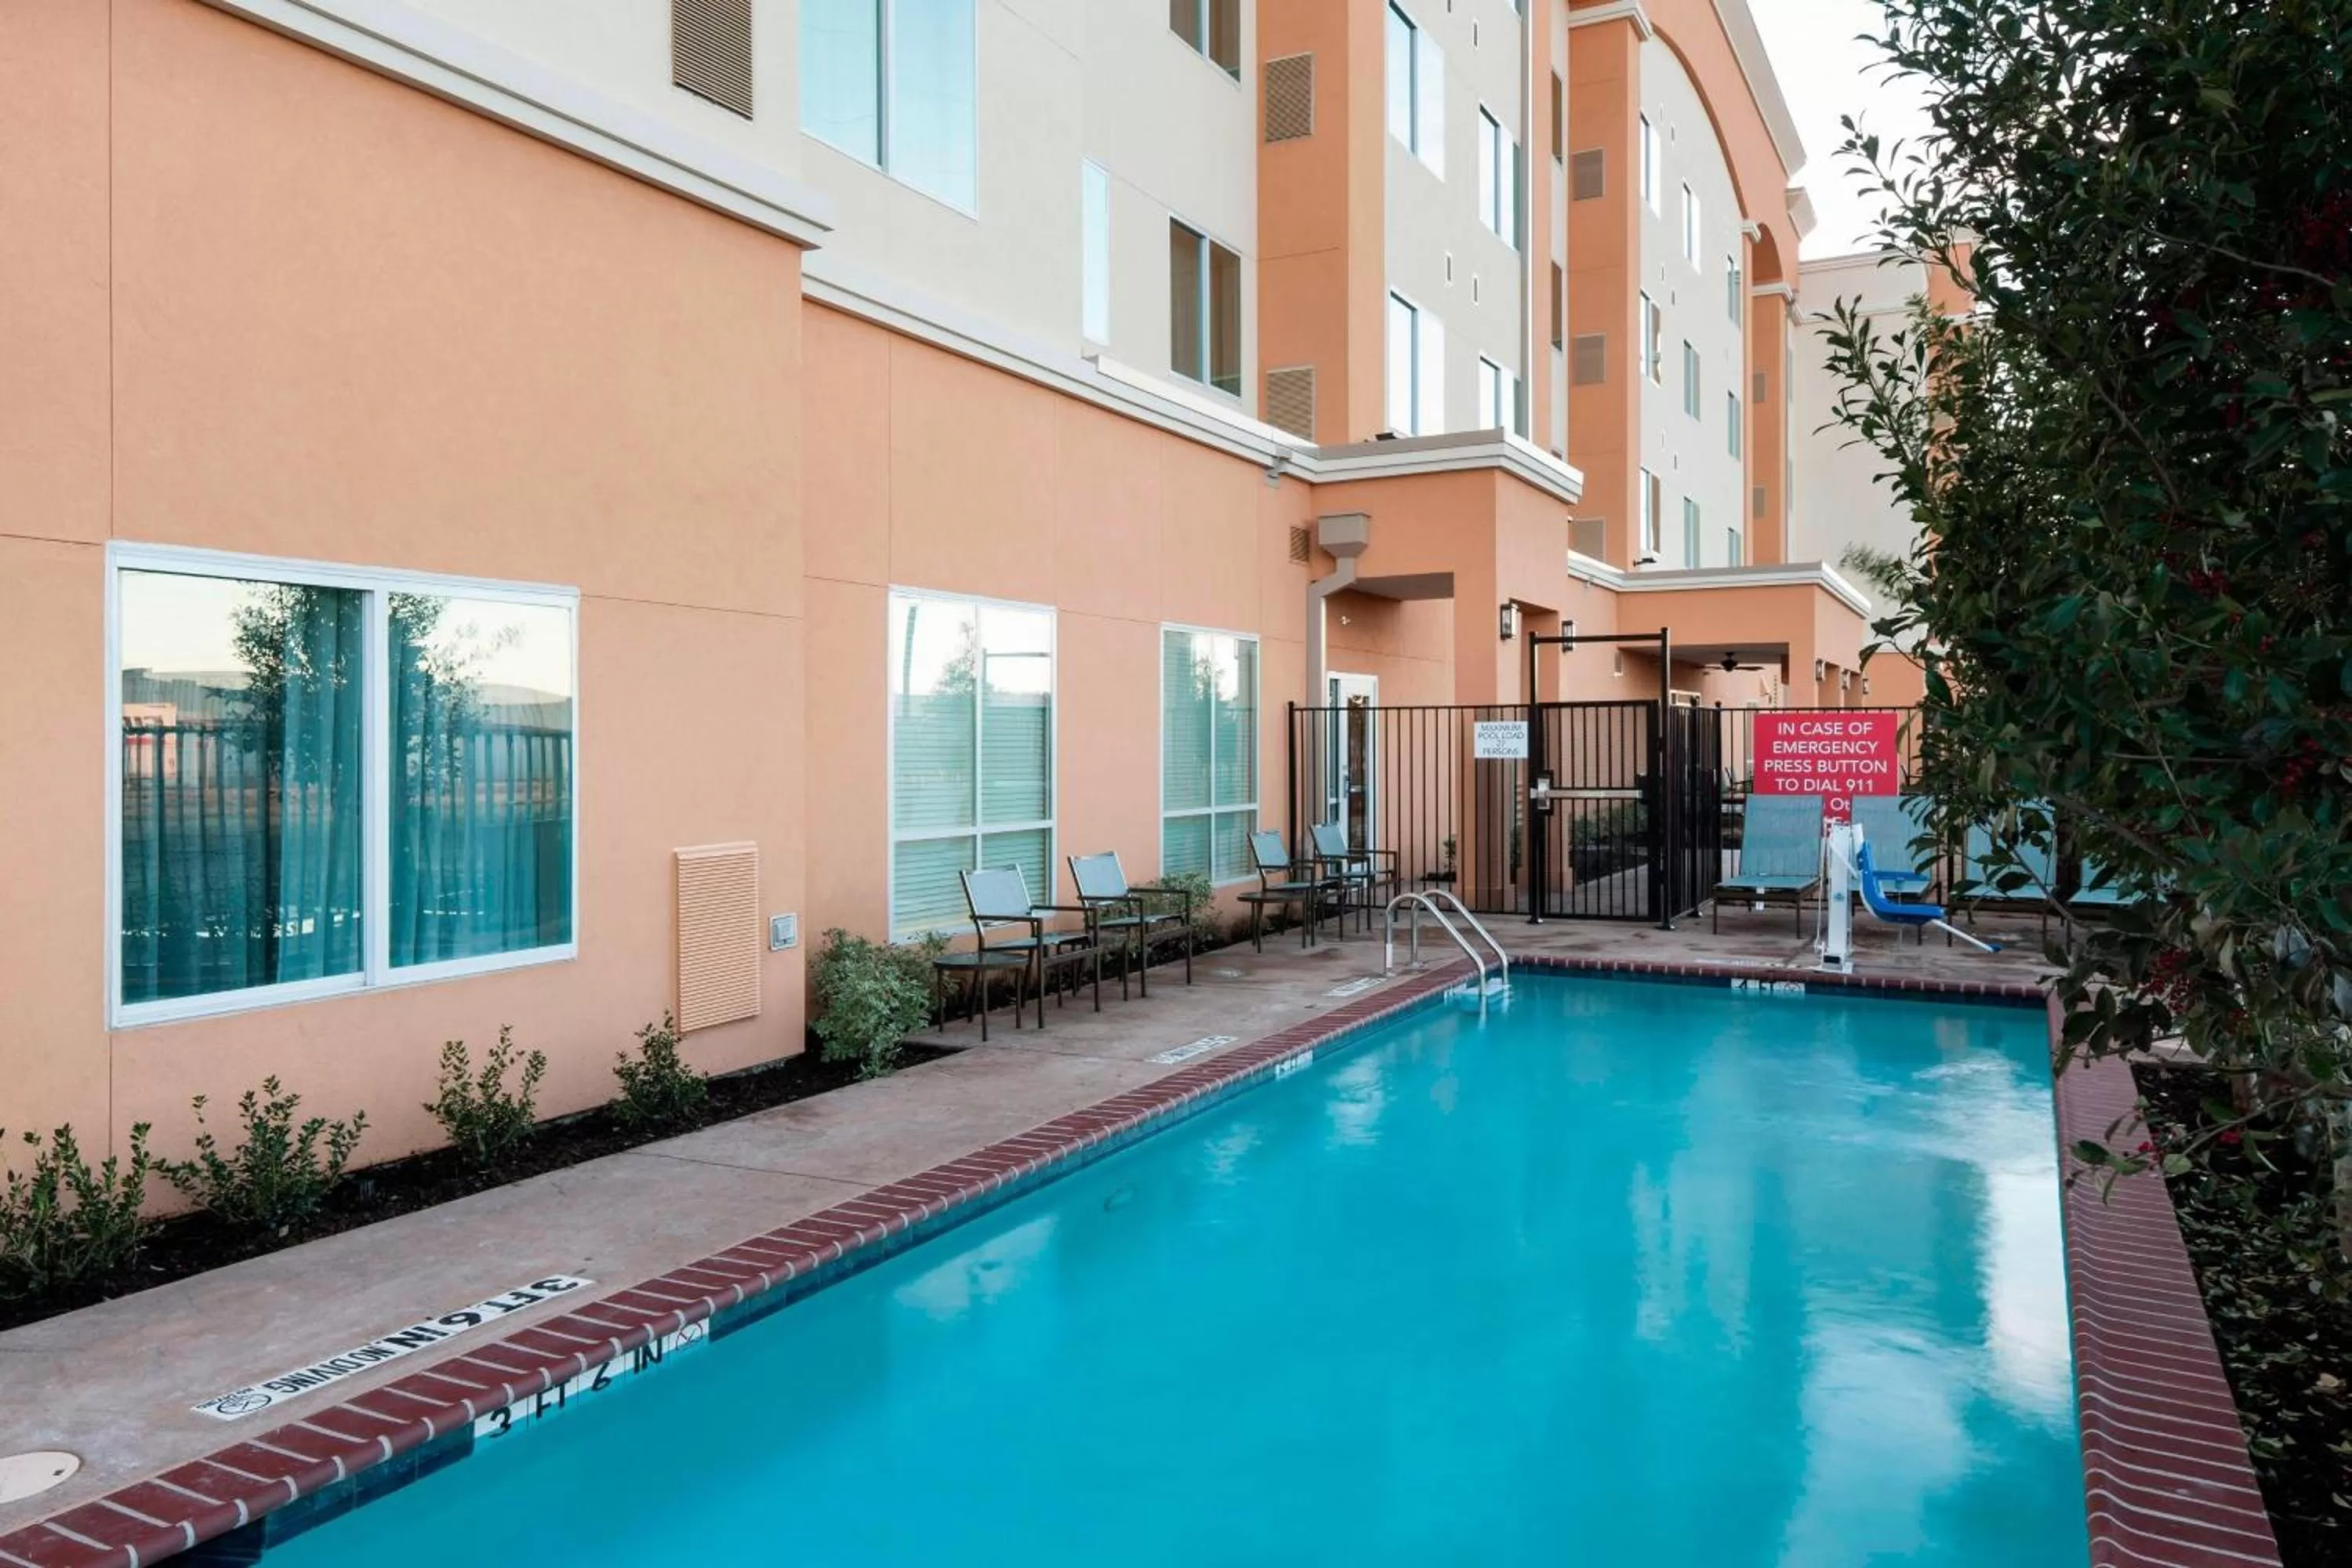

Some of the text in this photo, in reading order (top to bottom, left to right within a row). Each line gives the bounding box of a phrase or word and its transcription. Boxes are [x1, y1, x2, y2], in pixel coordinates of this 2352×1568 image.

[1777, 722, 1874, 735] IN CASE OF
[1482, 747, 1519, 756] PERSONS
[1773, 741, 1878, 754] EMERGENCY
[1763, 760, 1888, 774] PRESS BUTTON
[1775, 779, 1875, 792] TO DIAL 911
[530, 1279, 579, 1292] 3
[438, 1312, 481, 1327] 6
[347, 1346, 397, 1362] NO
[261, 1359, 366, 1393] DIVING
[488, 1338, 662, 1439] 3 FT 6 IN
